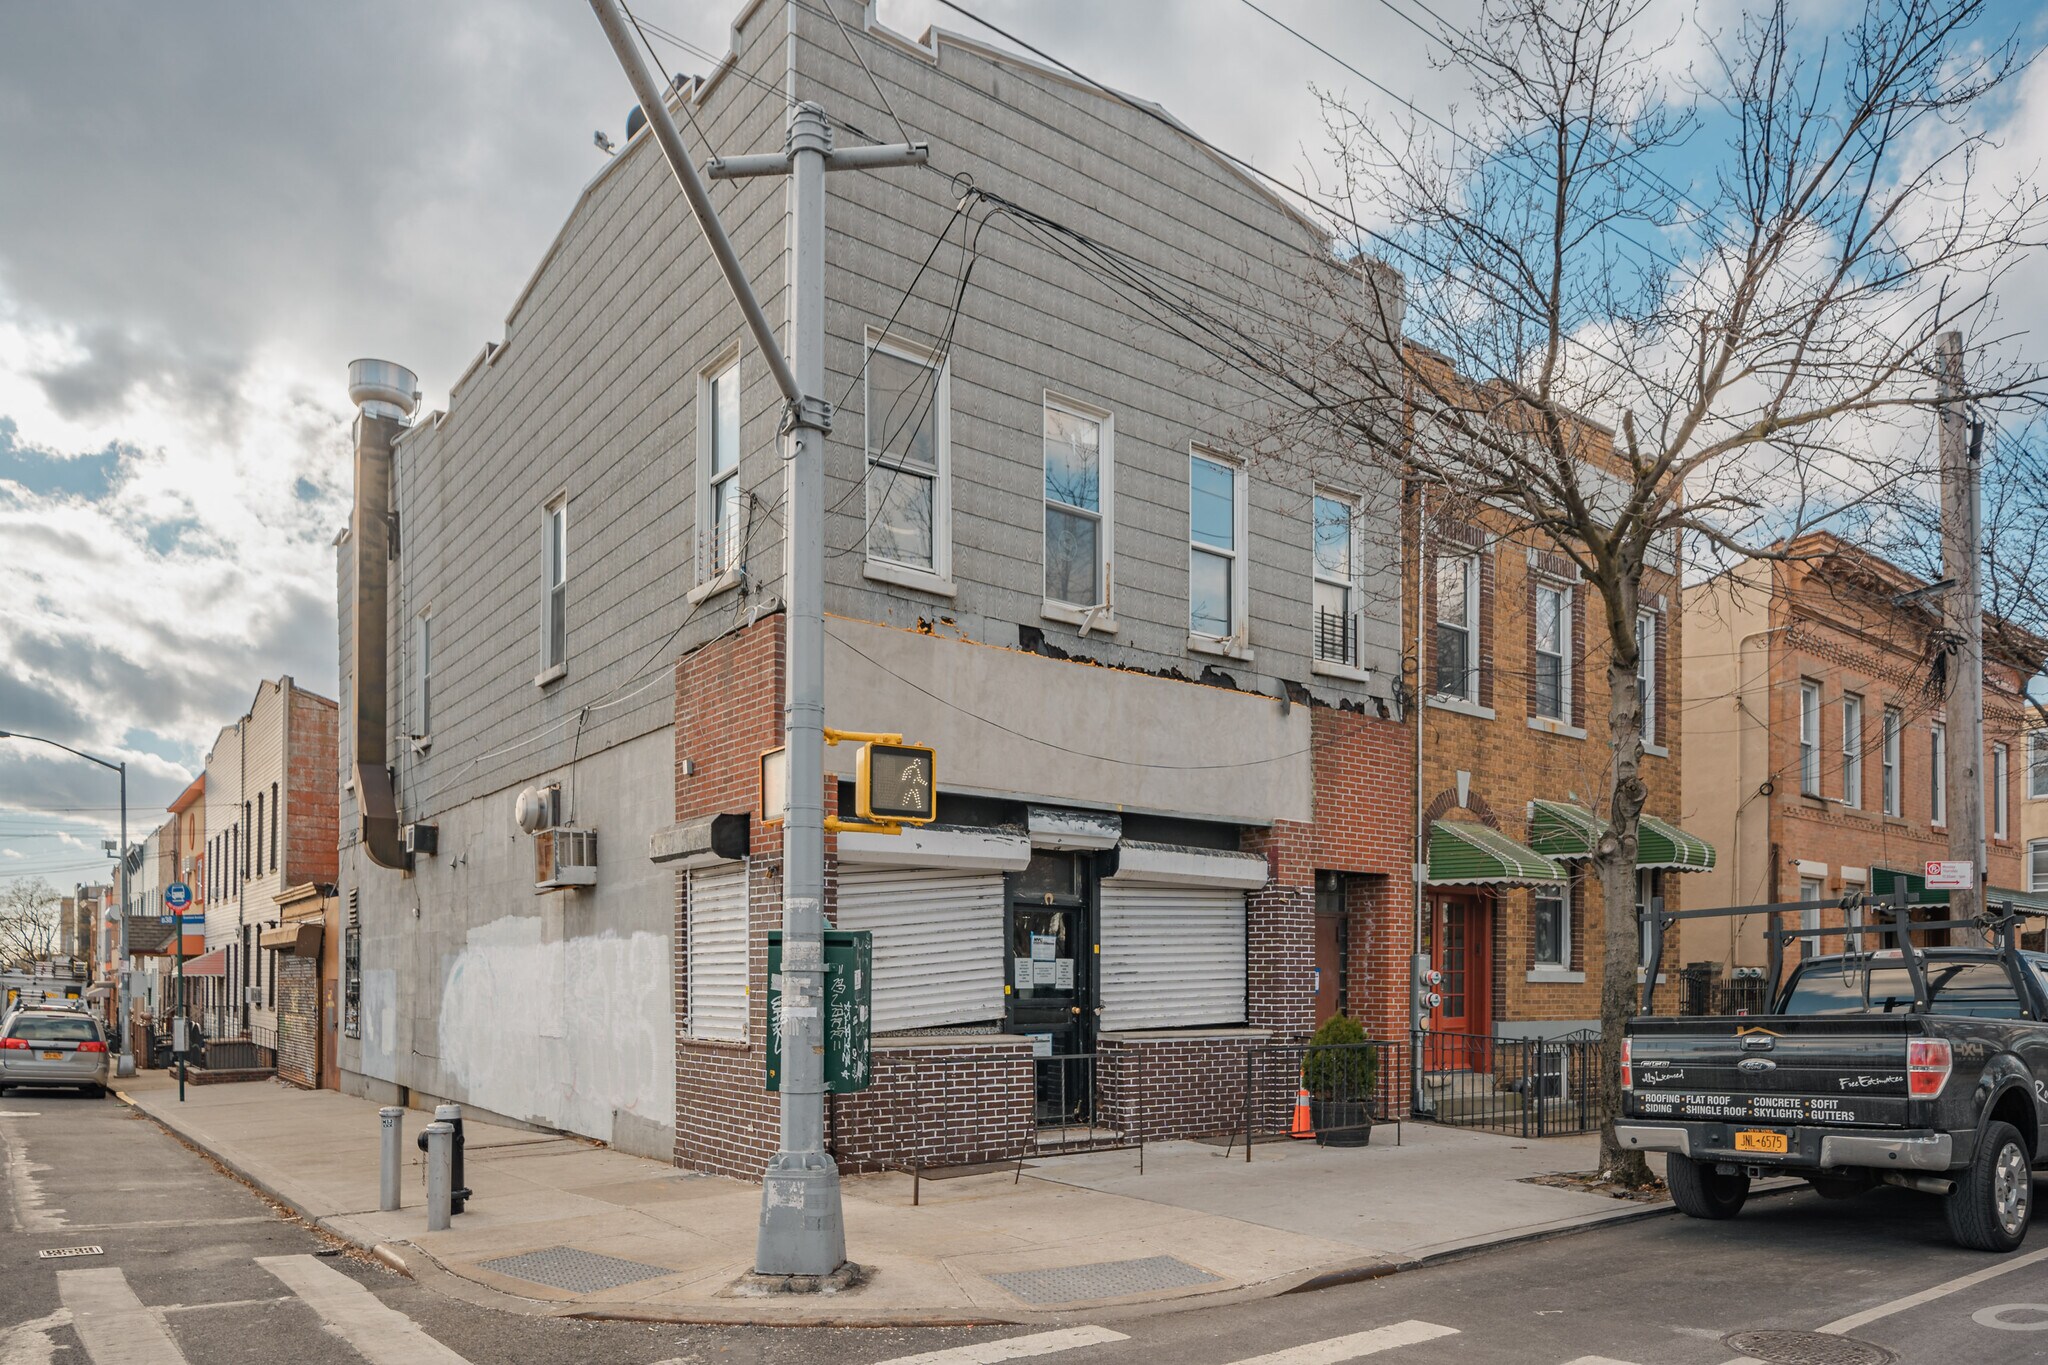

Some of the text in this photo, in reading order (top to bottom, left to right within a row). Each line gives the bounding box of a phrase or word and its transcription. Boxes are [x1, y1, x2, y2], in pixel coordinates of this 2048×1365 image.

[1857, 1075, 1904, 1087] Estimates
[1645, 1094, 1680, 1104] ROOFING
[1686, 1095, 1731, 1105] FLAT ROOF
[1753, 1097, 1801, 1108] CONCRETE
[1811, 1099, 1839, 1109] SOFIT
[1645, 1104, 1672, 1113] SIDING
[1686, 1105, 1748, 1116] SHINGLE ROOF
[1753, 1108, 1804, 1119] SKYLIGHTS
[1810, 1110, 1855, 1121] GUTTERS
[1740, 1134, 1782, 1149] JNL 6575
